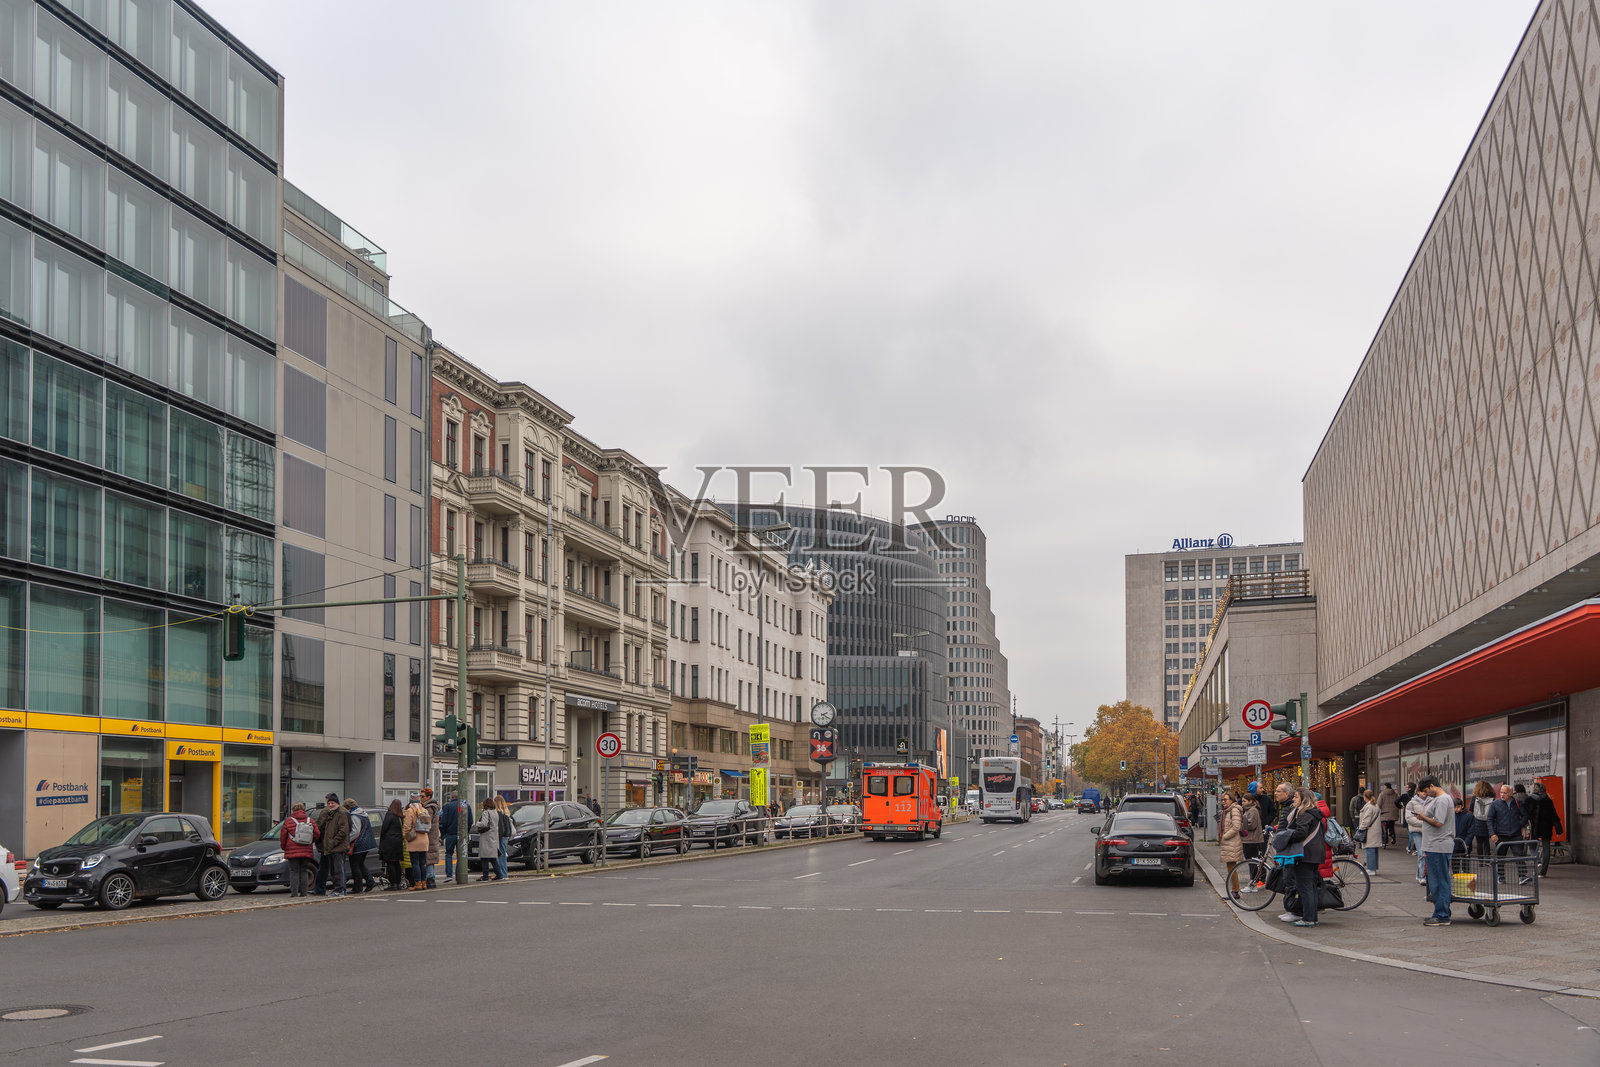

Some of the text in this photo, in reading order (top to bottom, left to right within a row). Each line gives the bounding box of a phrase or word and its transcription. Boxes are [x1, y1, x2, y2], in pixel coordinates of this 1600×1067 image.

[1172, 538, 1214, 549] Allianz
[591, 701, 608, 710] HOTELS
[1248, 707, 1267, 722] 30
[0, 716, 22, 724] ostbank
[140, 726, 162, 734] Postbank
[254, 734, 271, 742] Postbank
[601, 739, 616, 751] 30
[816, 744, 827, 752] 36
[188, 747, 216, 757] Postbank
[53, 782, 88, 792] Postbank
[39, 796, 85, 806] #diepasstbank
[895, 803, 912, 812] 112
